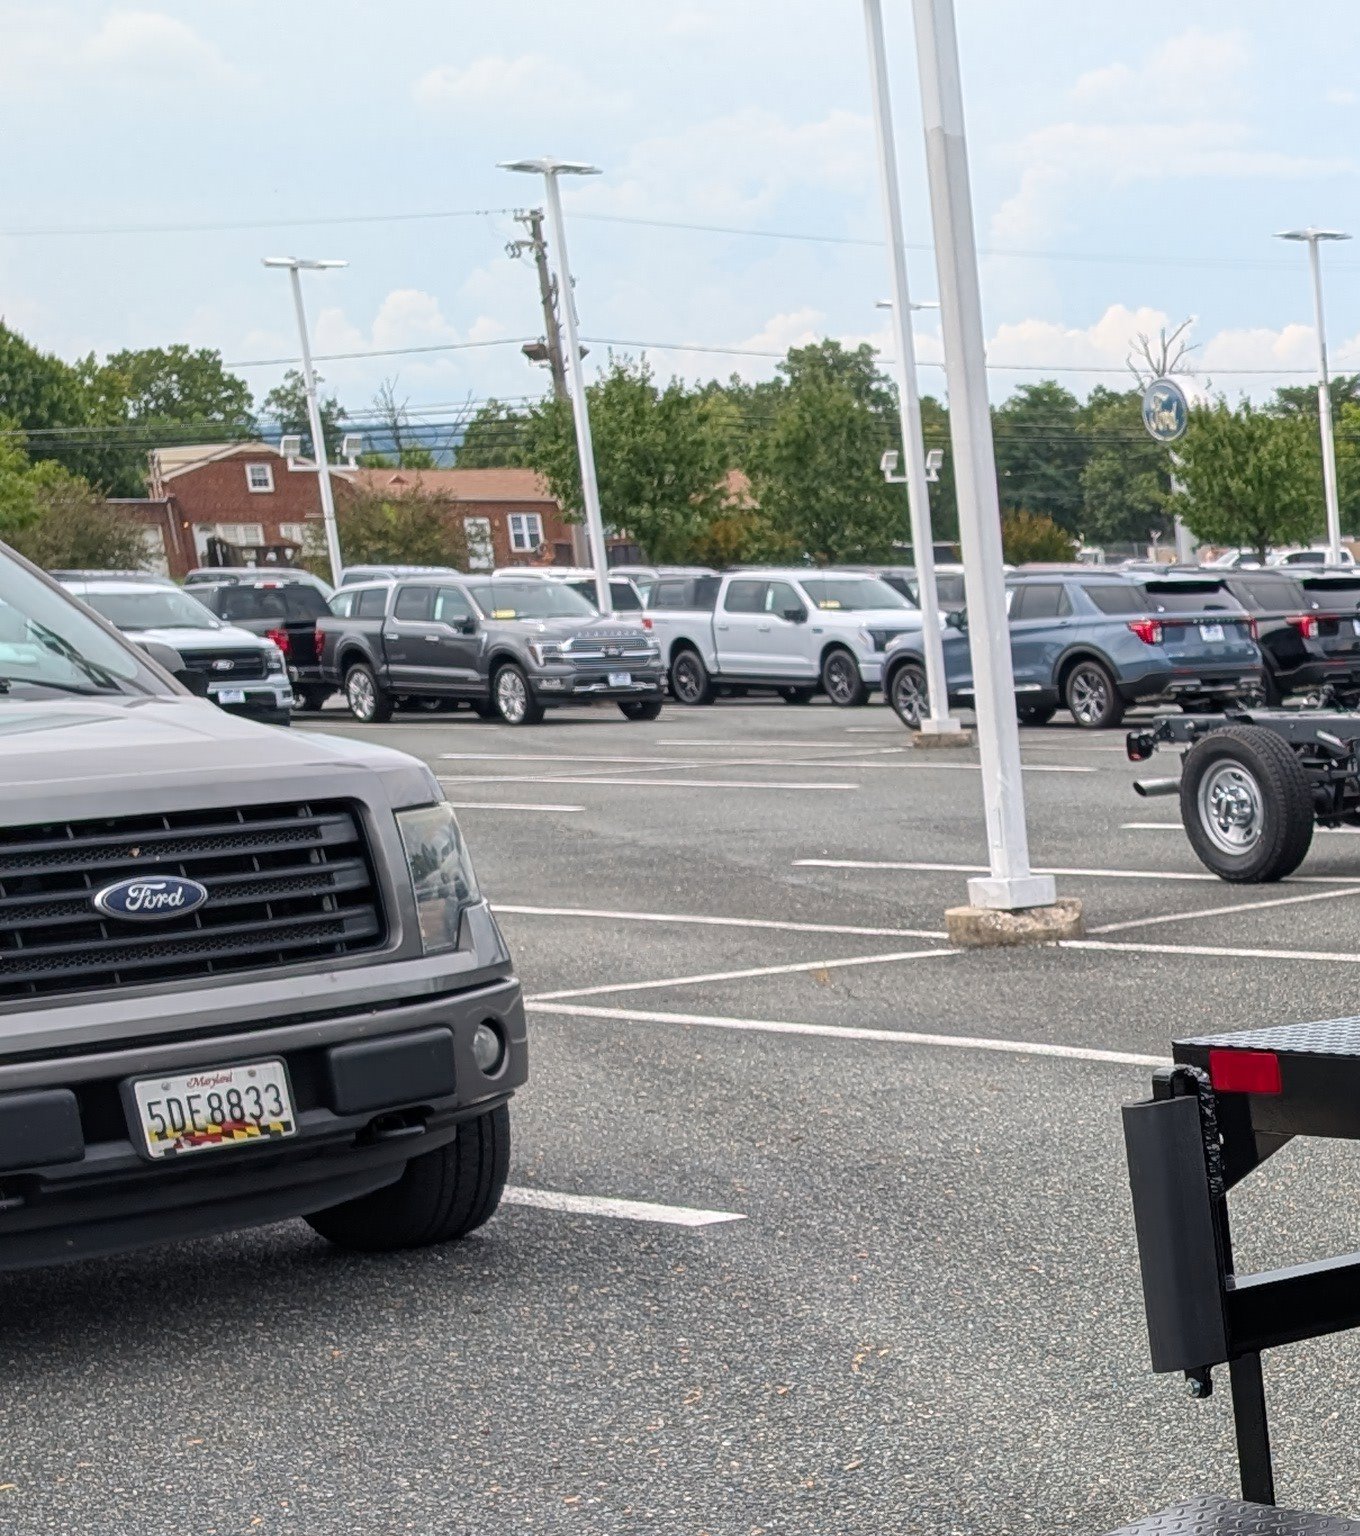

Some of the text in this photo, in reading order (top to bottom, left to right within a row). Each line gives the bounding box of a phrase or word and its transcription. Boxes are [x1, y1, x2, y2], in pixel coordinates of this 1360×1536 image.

[1150, 392, 1178, 431] Ford
[125, 882, 185, 911] Ford
[187, 1071, 233, 1089] Maryland
[147, 1083, 284, 1141] 5DE8833
